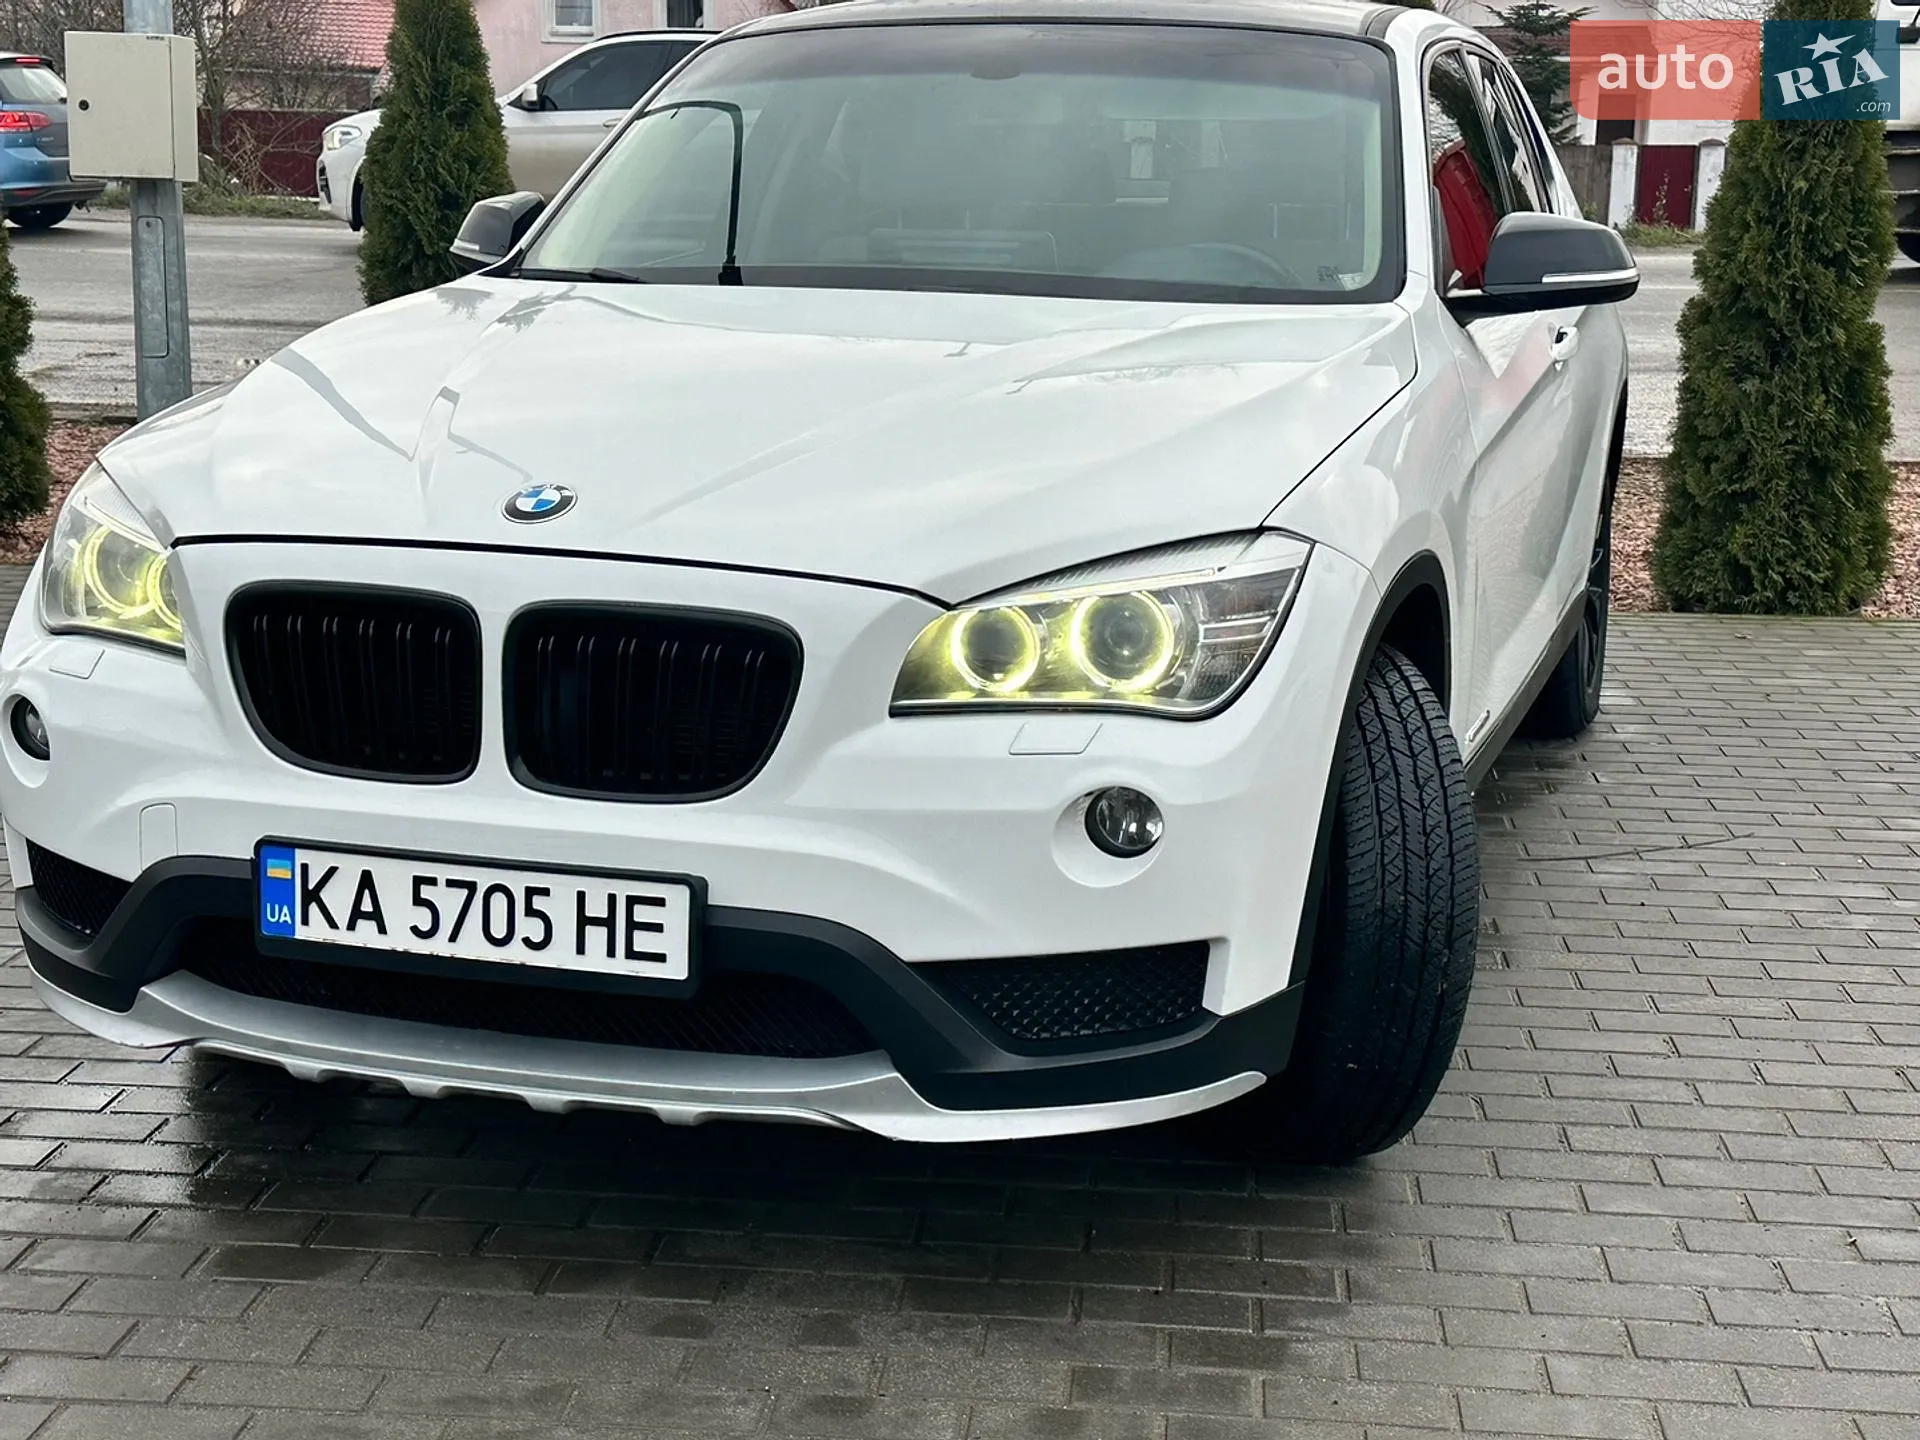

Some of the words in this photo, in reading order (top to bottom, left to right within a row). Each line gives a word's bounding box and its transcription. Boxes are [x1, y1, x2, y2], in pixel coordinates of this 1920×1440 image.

[266, 902, 292, 925] UA
[300, 862, 388, 935] KA
[409, 874, 553, 951] 5705
[576, 890, 667, 963] HE
